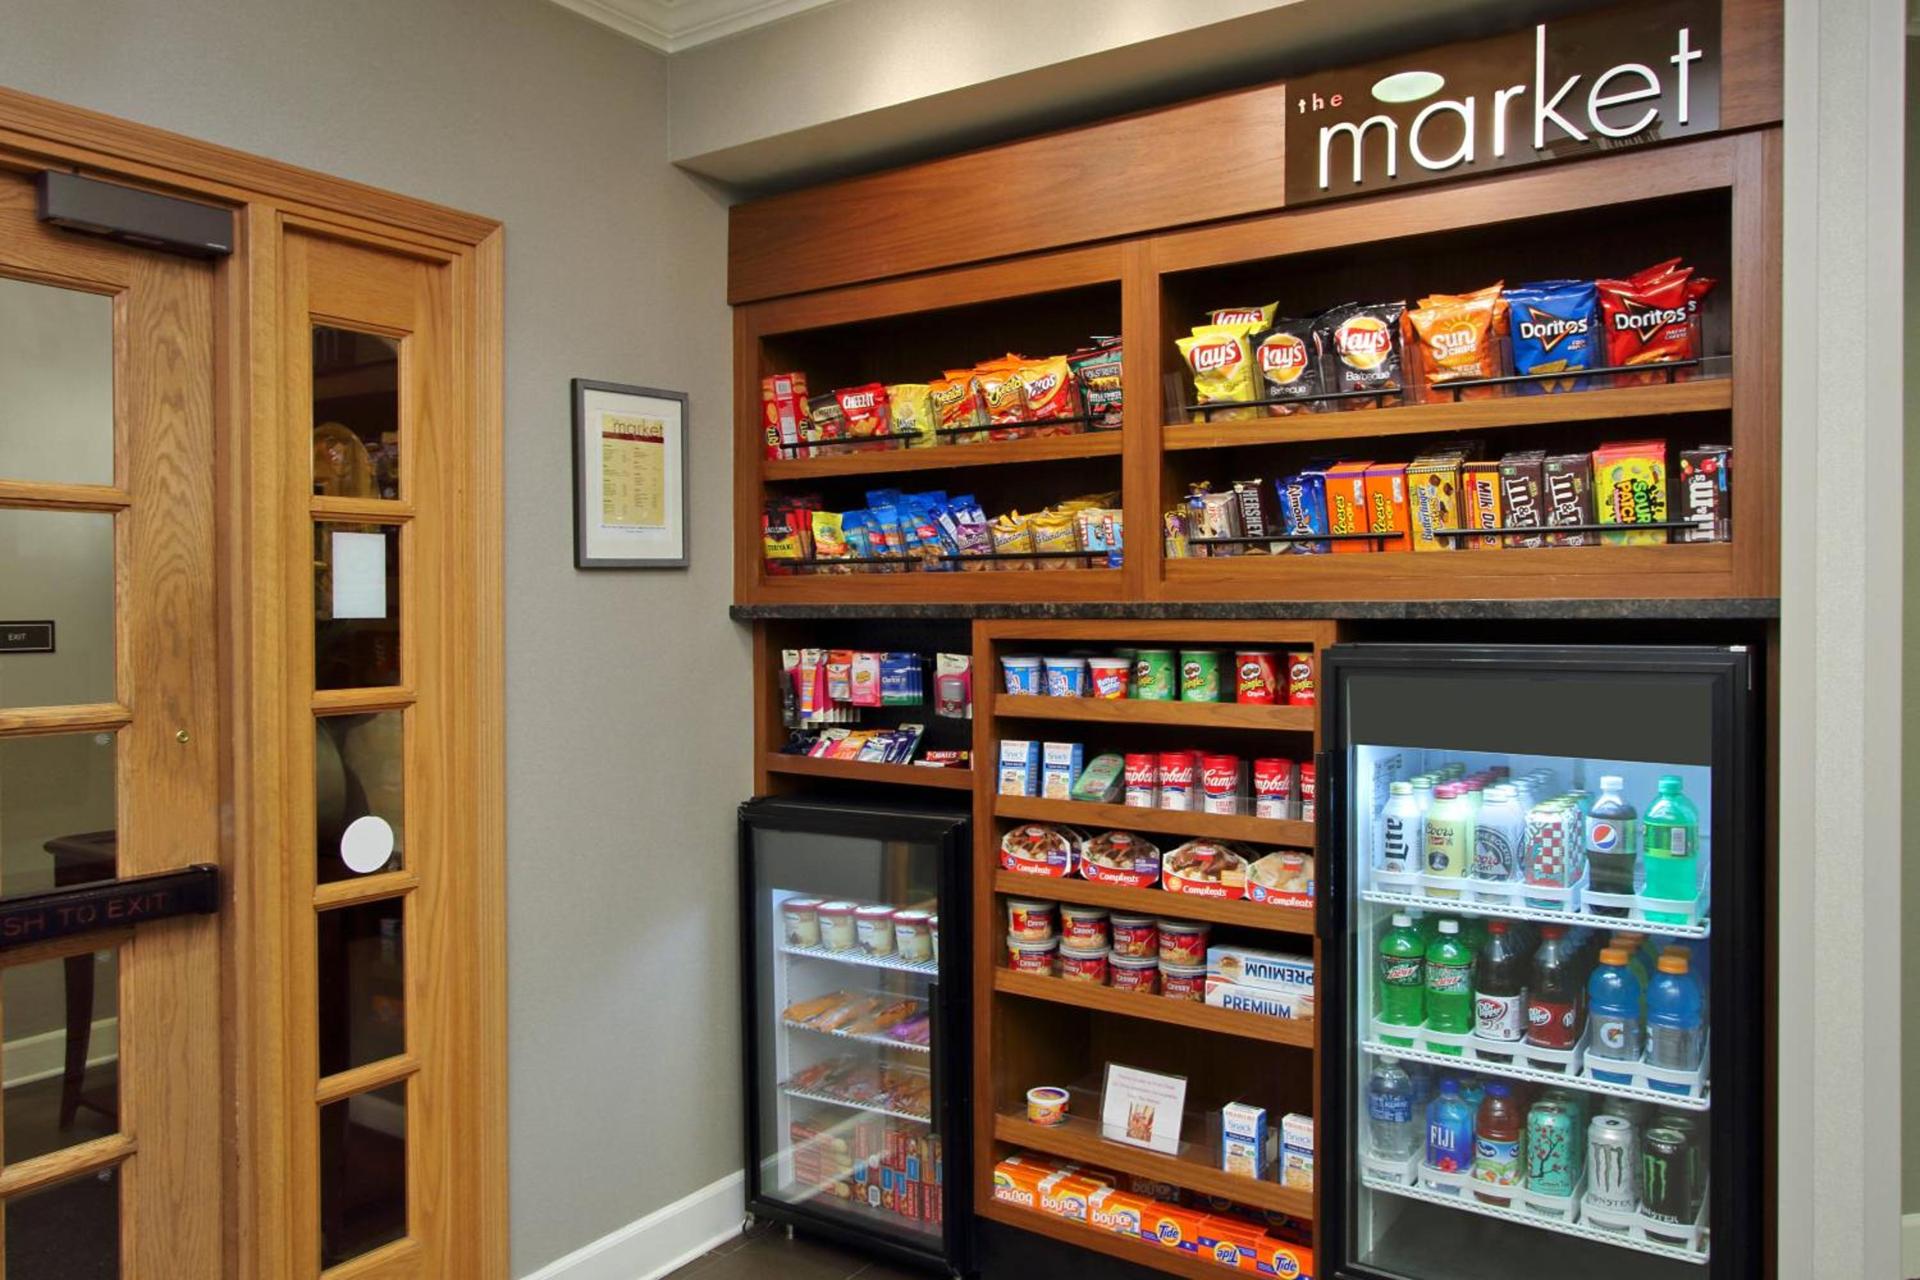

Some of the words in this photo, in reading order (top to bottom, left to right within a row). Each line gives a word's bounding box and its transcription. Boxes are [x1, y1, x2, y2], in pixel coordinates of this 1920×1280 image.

[1298, 91, 1343, 114] the
[1318, 24, 1702, 190] market
[1520, 317, 1588, 339] Doritos
[1615, 307, 1687, 330] Doritos
[1243, 488, 1264, 537] HERSHEY
[1633, 481, 1651, 523] SOUR
[8, 633, 26, 641] EXIT
[1385, 817, 1409, 861] Lite
[1425, 822, 1455, 836] Coors
[4, 914, 45, 936] SH
[57, 906, 95, 928] TO
[108, 892, 168, 919] EXIT
[1244, 960, 1313, 986] PREMIUM
[1223, 993, 1292, 1019] PREMIUM
[1600, 1022, 1624, 1048] G
[1430, 1124, 1454, 1149] FIJI
[1041, 1196, 1079, 1213] bounce
[1092, 1211, 1132, 1226] bounce
[1158, 1224, 1180, 1239] Tide
[1216, 1249, 1238, 1263] Tide
[1275, 1255, 1298, 1272] Tide
